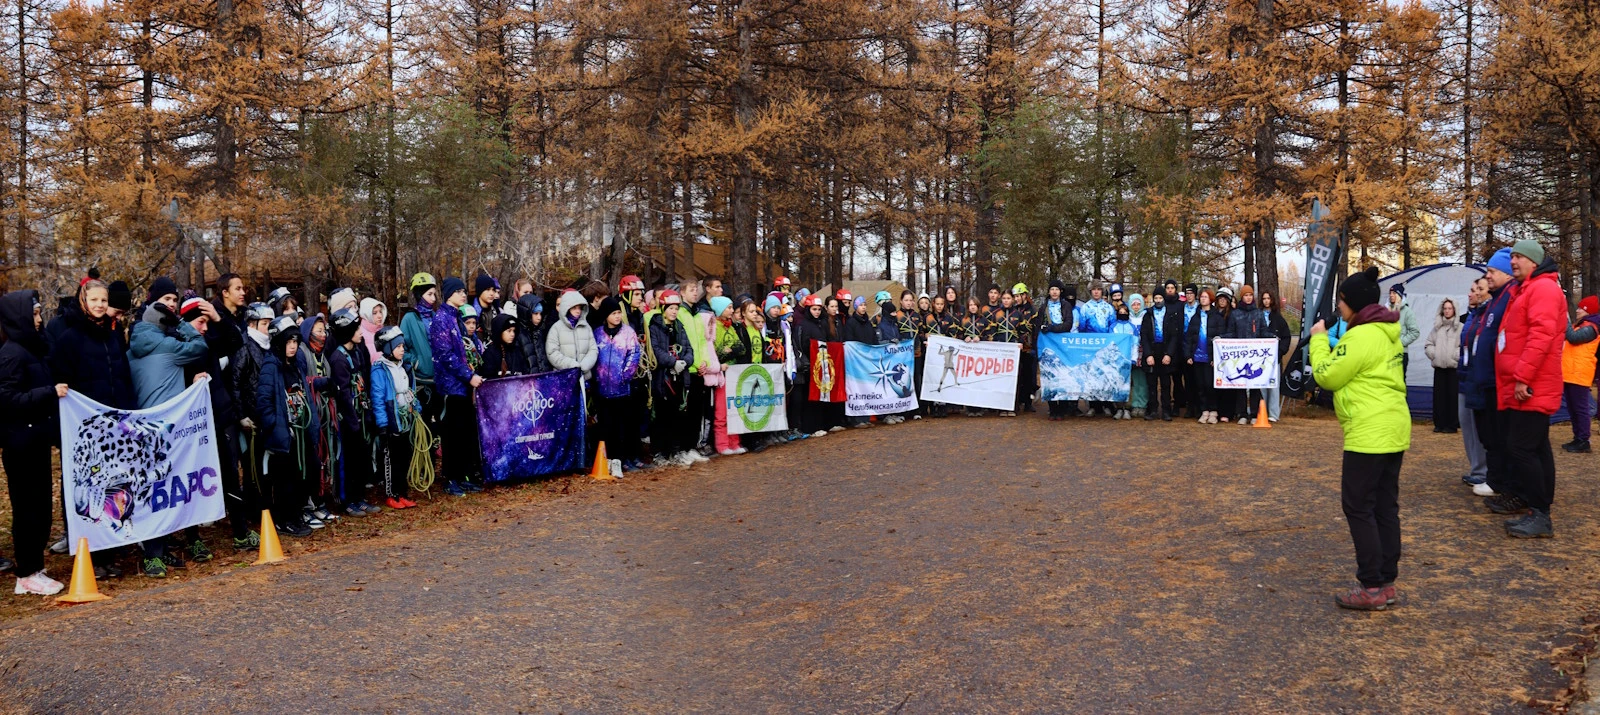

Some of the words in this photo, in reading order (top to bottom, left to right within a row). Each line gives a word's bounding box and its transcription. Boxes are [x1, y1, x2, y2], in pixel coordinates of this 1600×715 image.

[1062, 337, 1107, 345] EVEREST
[1220, 348, 1273, 360] ВИРАЖ
[956, 354, 1014, 378] ПРОРЫВ
[512, 397, 555, 412] КОСМОС
[727, 393, 785, 409] ГОРИЗОНТ
[150, 466, 218, 514] БАРС
